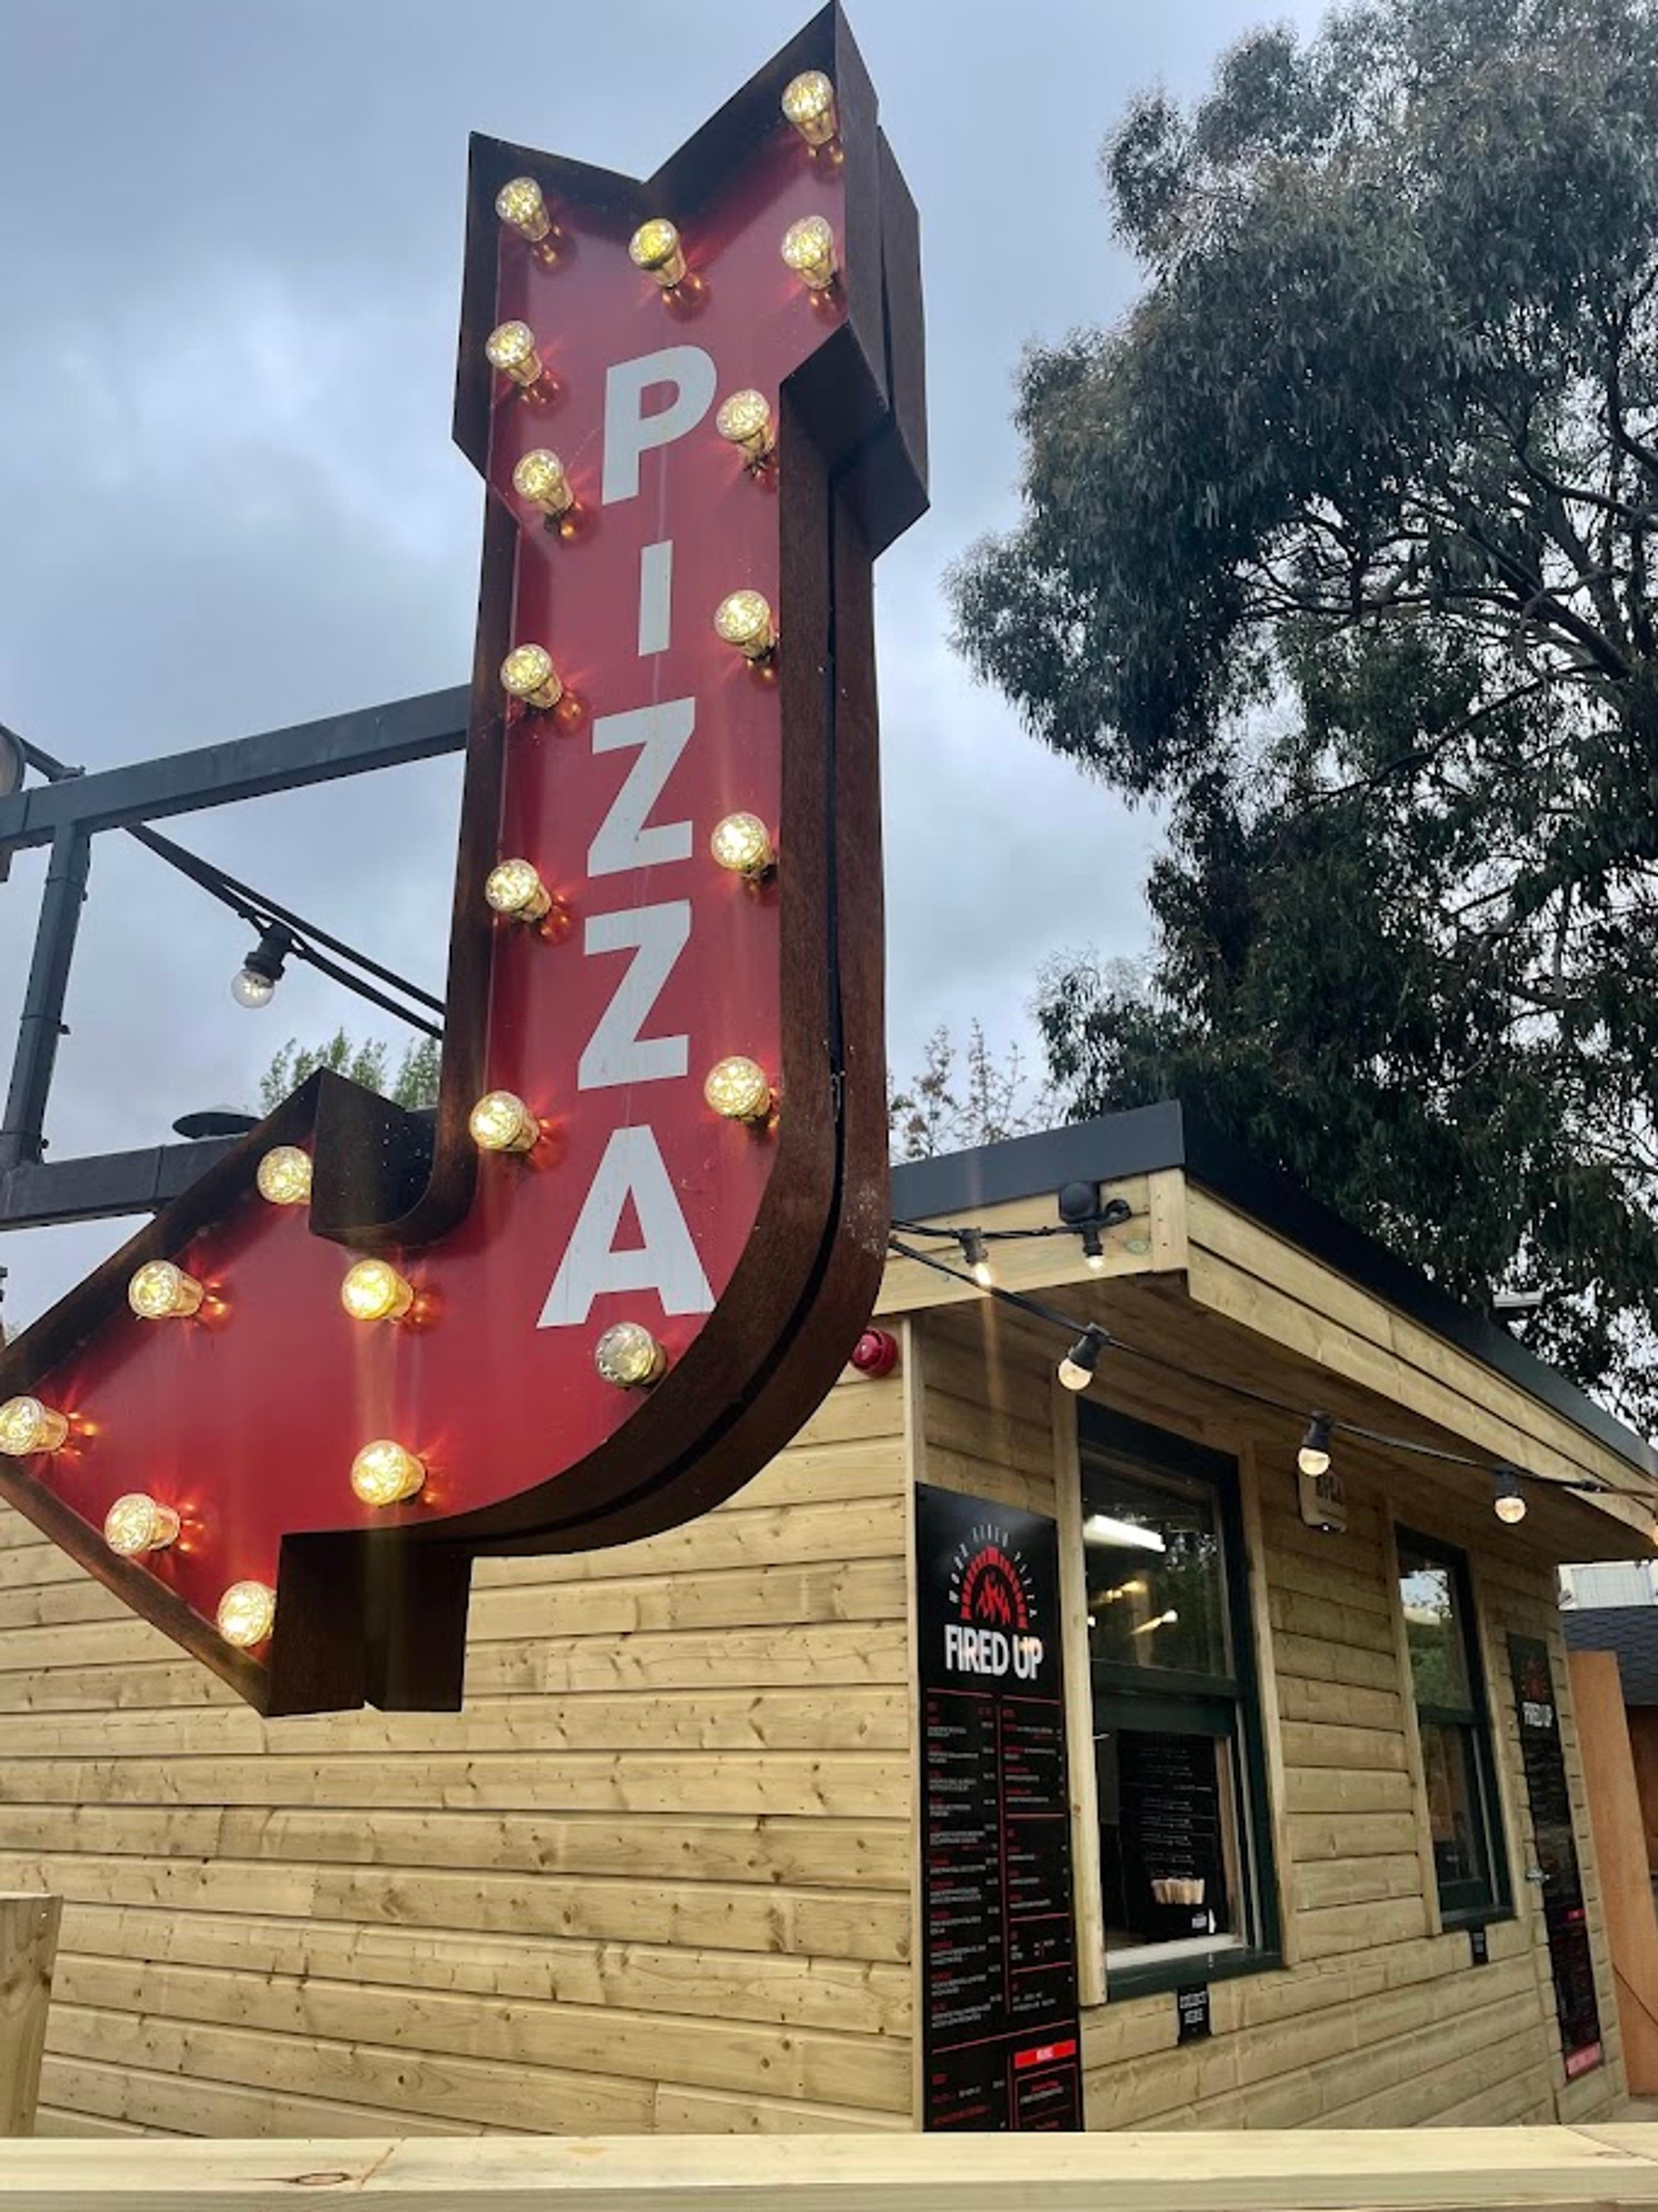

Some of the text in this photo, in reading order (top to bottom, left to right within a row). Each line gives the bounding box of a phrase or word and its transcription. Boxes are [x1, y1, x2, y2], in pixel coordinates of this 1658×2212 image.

[537, 344, 718, 1328] PIZZA
[944, 1624, 1043, 1680] FIRED UP
